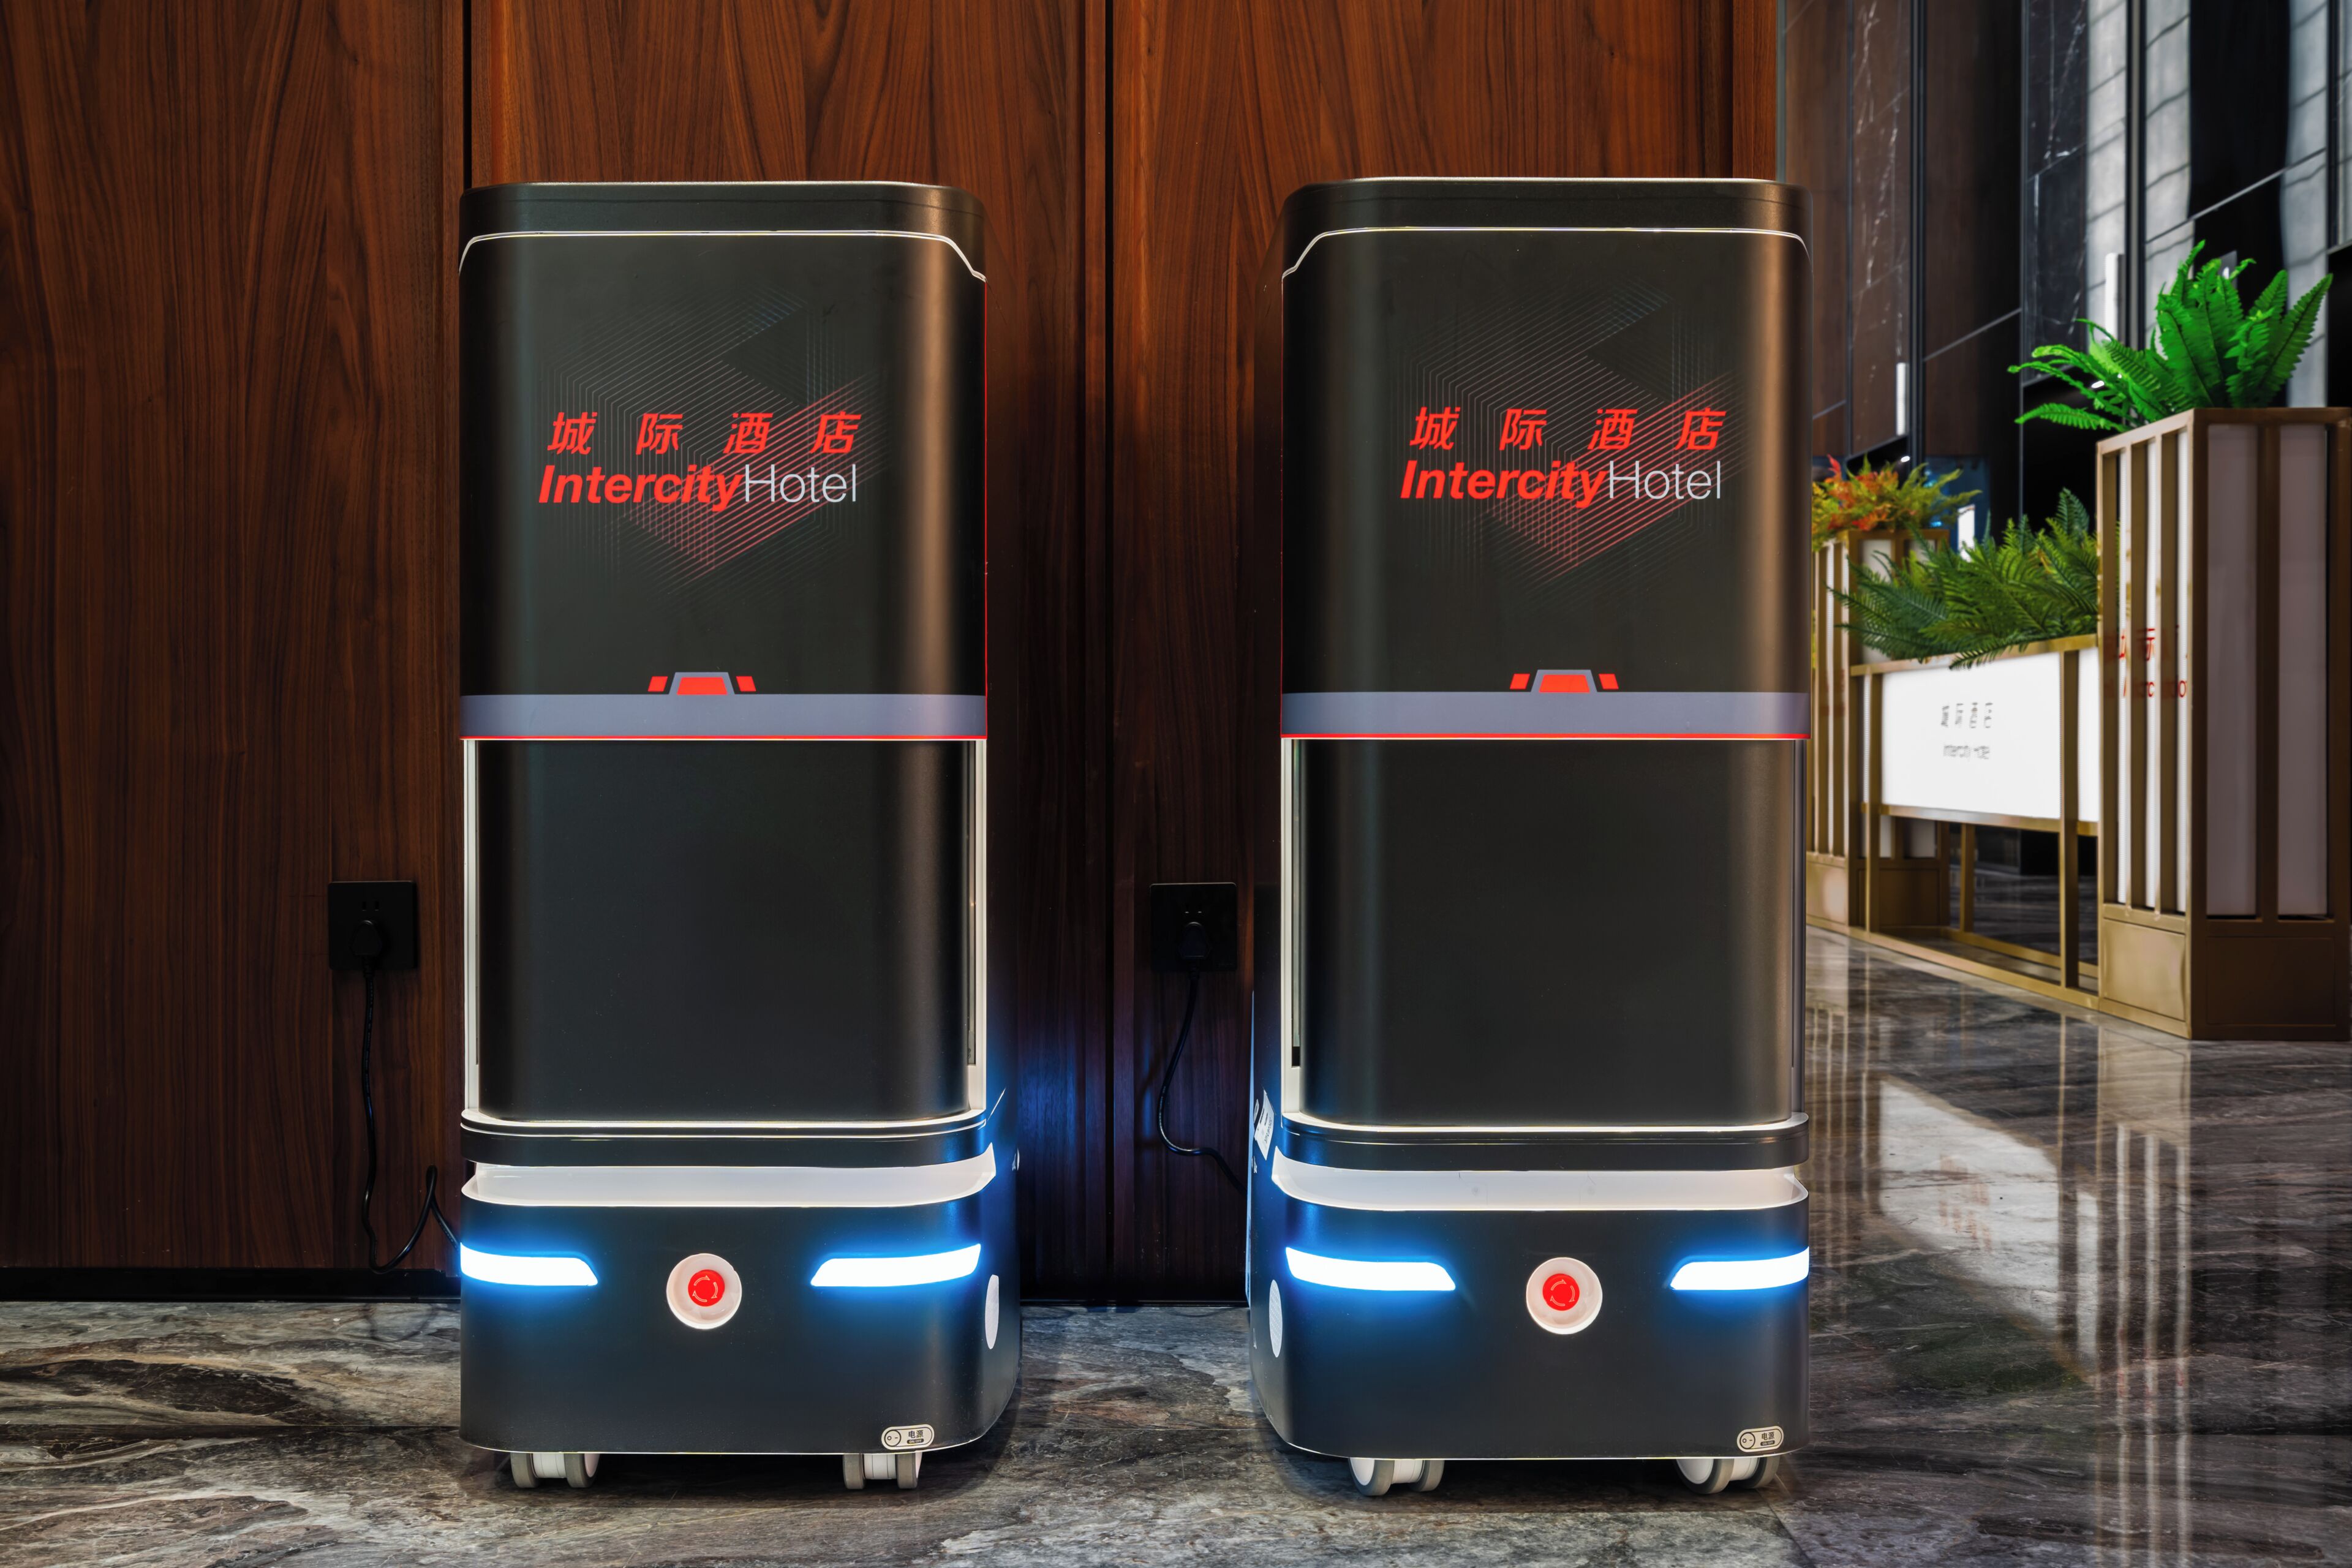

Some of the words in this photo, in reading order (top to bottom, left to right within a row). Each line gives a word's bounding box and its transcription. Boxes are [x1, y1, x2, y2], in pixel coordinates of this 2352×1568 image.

[547, 412, 861, 454] 城际酒店
[1409, 407, 1726, 450] 城际酒店
[908, 1430, 924, 1438] 电源
[1762, 1431, 1774, 1440] 电源
